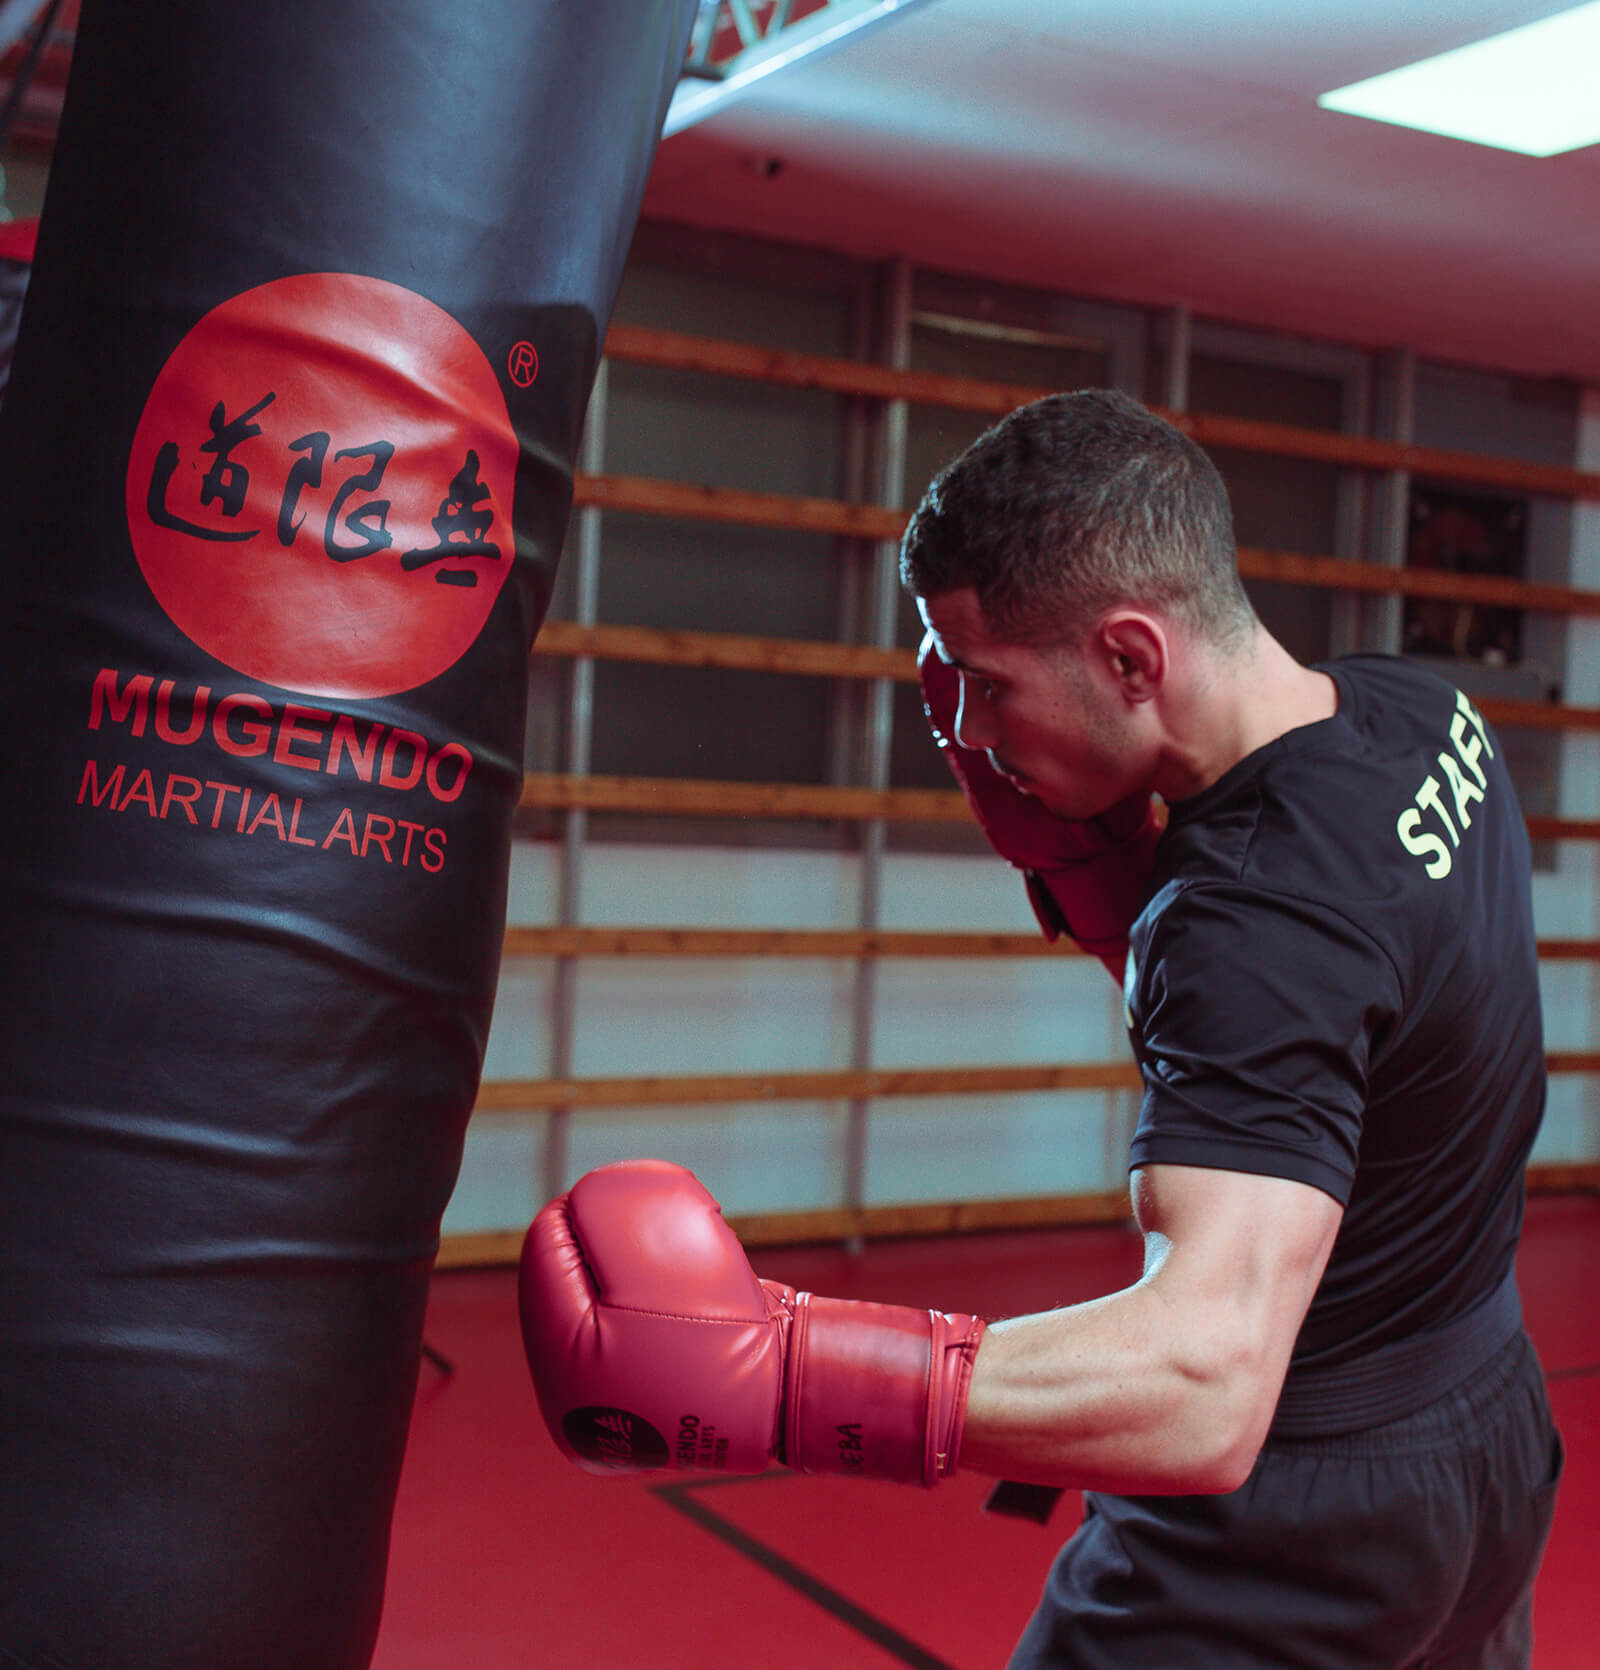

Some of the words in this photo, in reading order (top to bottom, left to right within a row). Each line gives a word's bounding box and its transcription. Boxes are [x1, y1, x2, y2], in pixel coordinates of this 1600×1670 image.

[87, 668, 473, 802] MUGENDO
[76, 759, 317, 848] MARTIAL
[321, 807, 448, 873] ARTS
